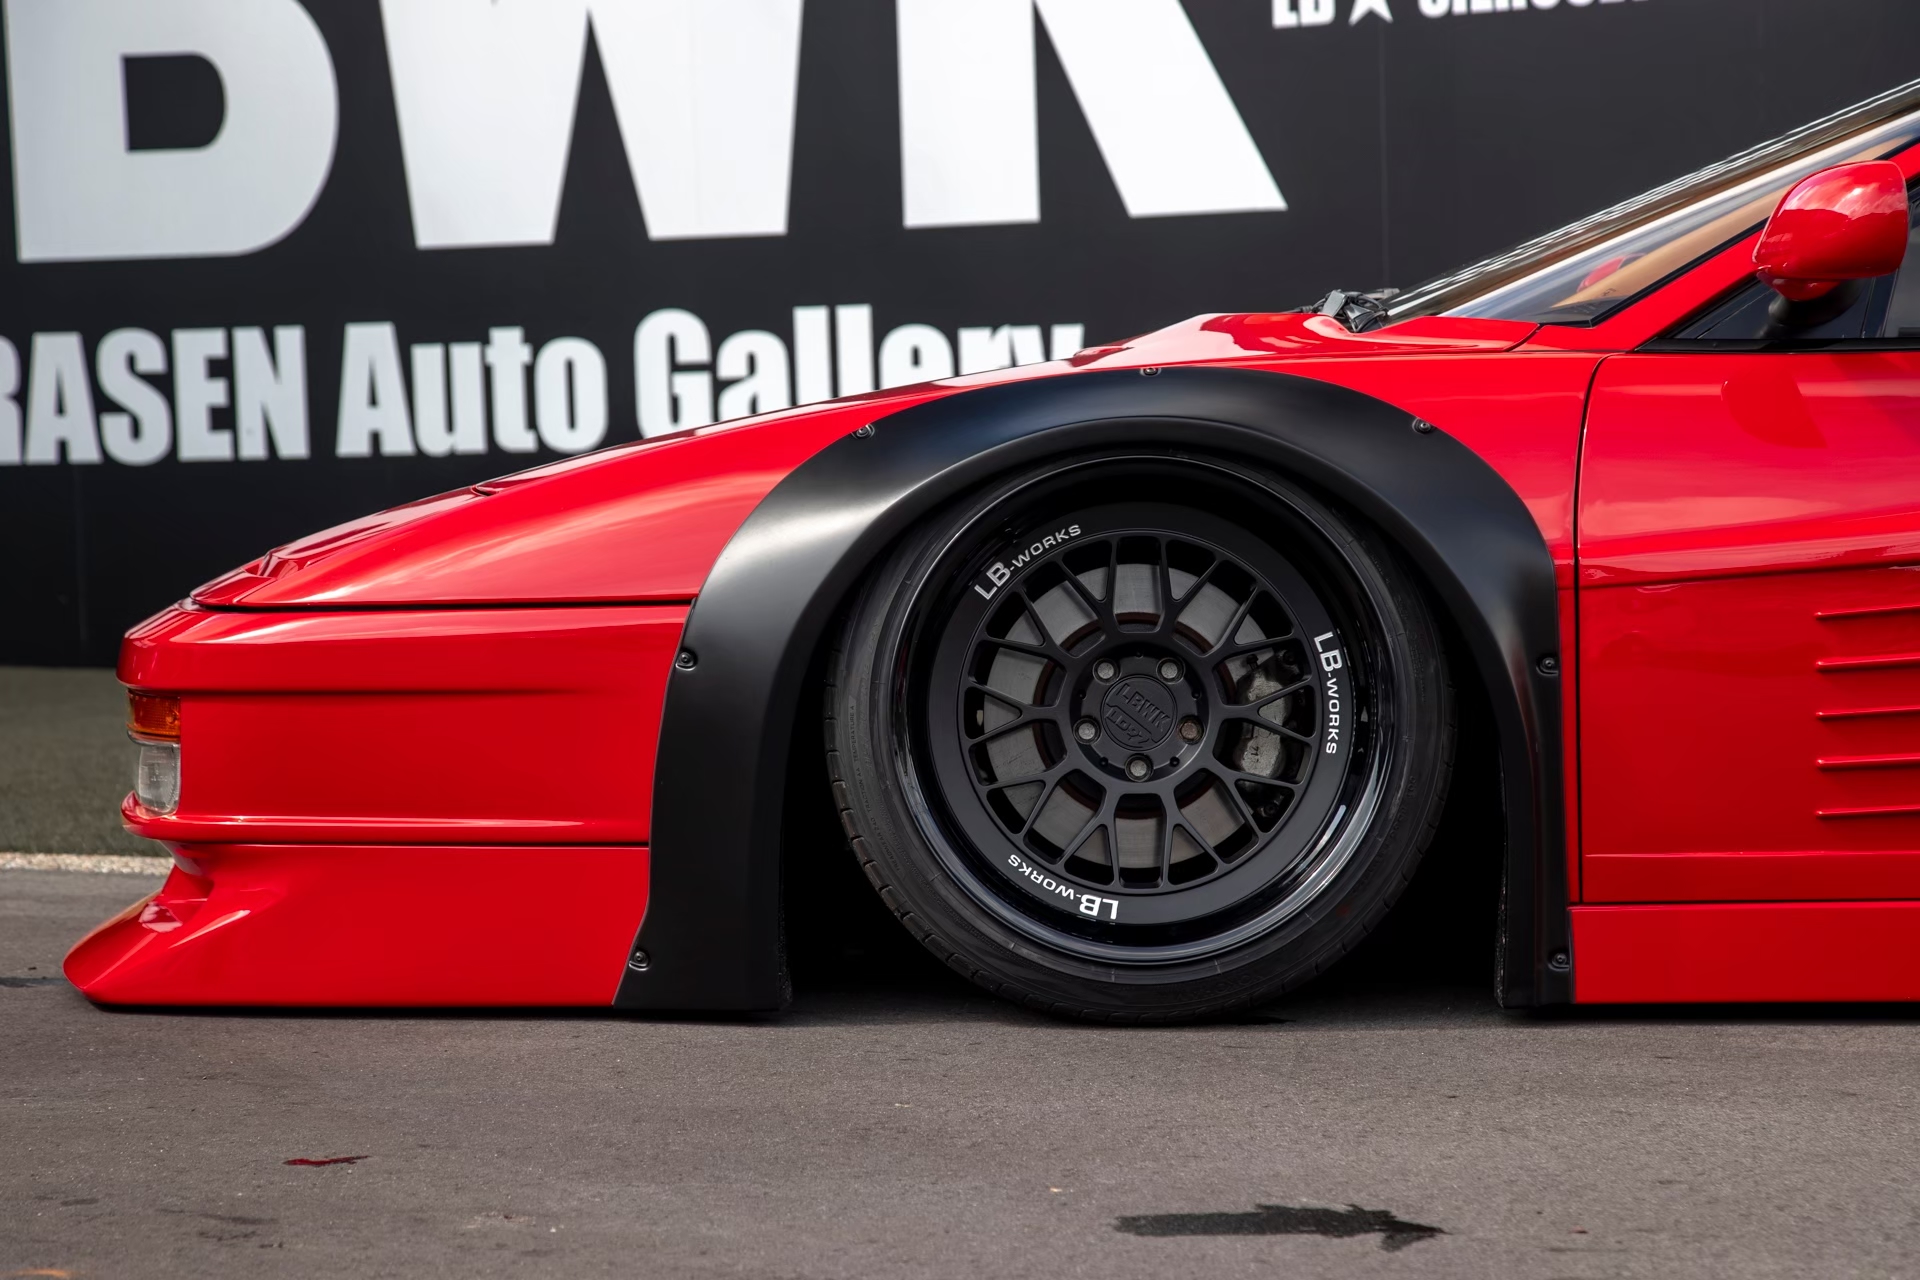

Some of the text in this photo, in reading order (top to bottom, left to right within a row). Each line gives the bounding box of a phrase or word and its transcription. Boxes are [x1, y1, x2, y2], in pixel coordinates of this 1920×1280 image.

[336, 322, 609, 457] Auto
[974, 524, 1082, 600] LB-WORKS
[1313, 631, 1343, 755] LB-WORKS
[850, 712, 858, 762] TEMPERATURE
[1007, 854, 1119, 920] LB-WORKS
